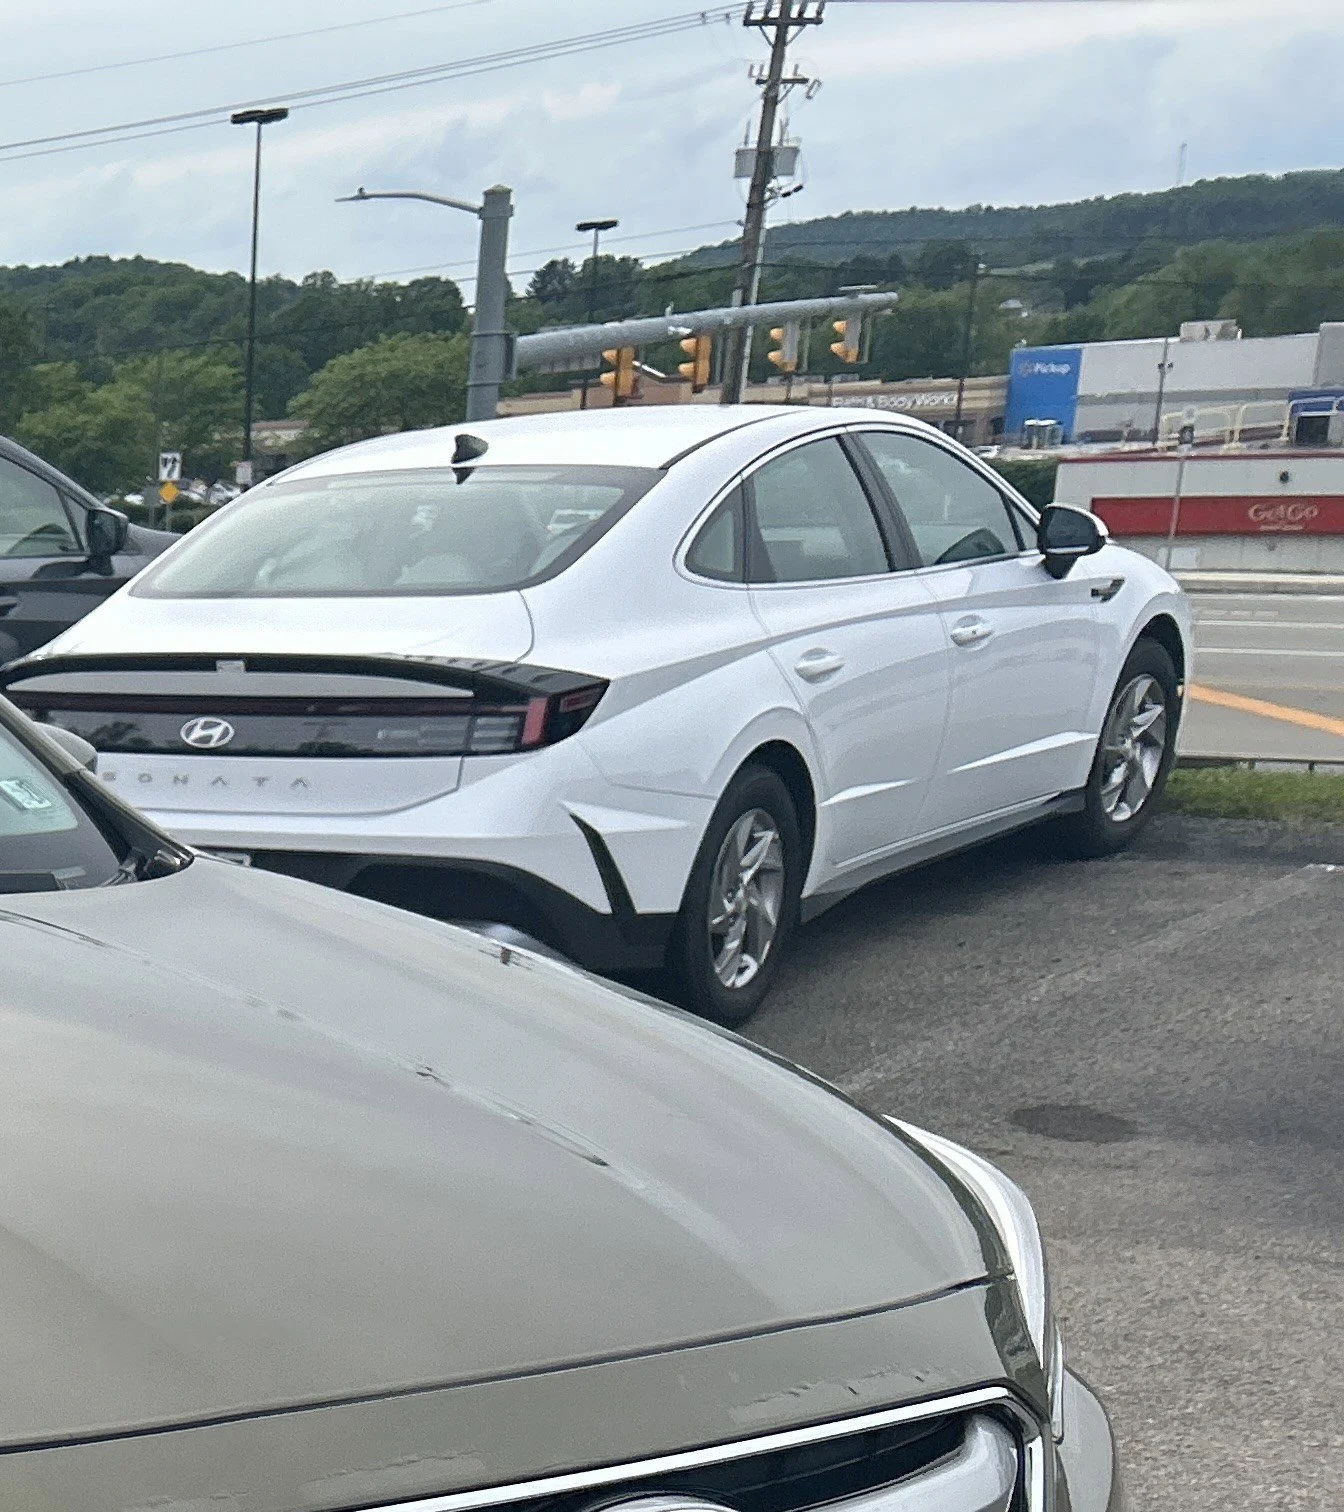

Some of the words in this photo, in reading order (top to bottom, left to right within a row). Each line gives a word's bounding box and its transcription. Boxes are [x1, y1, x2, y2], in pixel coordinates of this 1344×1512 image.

[1034, 362, 1071, 375] Pickup
[1248, 504, 1319, 521] GetGo
[102, 770, 309, 788] SONATA
